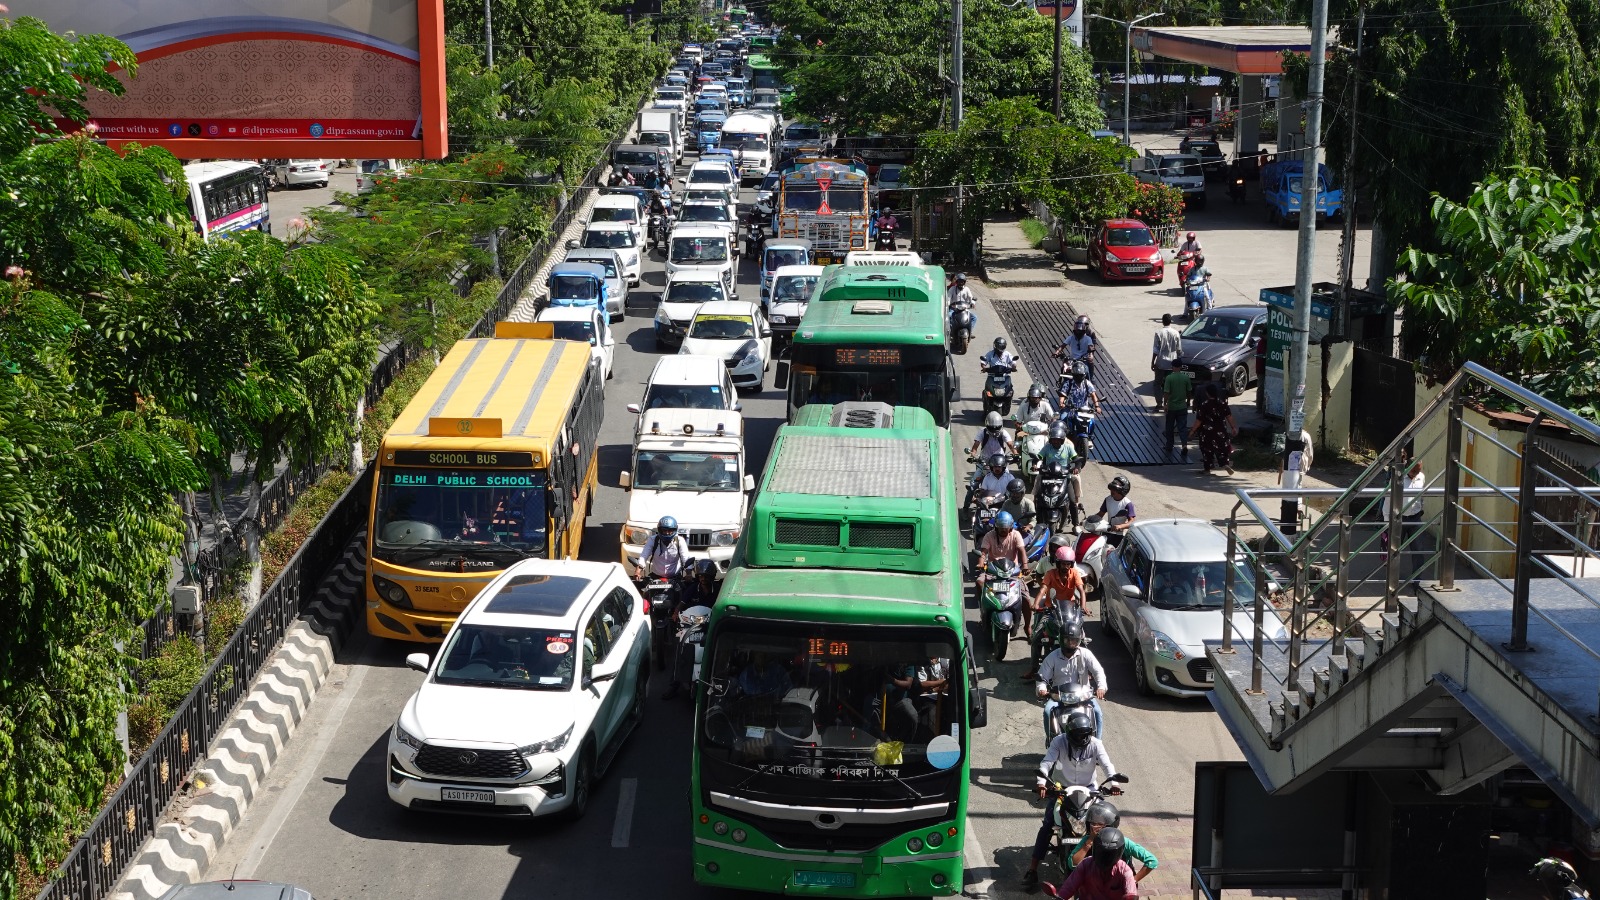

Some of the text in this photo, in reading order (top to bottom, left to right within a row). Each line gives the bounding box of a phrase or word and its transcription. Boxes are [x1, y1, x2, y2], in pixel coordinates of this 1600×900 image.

[93, 125, 404, 137] nnect with us @diprassam dipr.assam.gov.in
[1270, 310, 1294, 329] POLL
[1270, 329, 1293, 342] TESTIN
[1270, 350, 1284, 362] GOV
[460, 421, 471, 432] 32
[429, 453, 498, 464] SCHOOL BUS
[394, 475, 533, 486] DELHI PUBLIC SCHOOL
[808, 638, 825, 655] 1E
[447, 791, 493, 802] AS01FP7000
